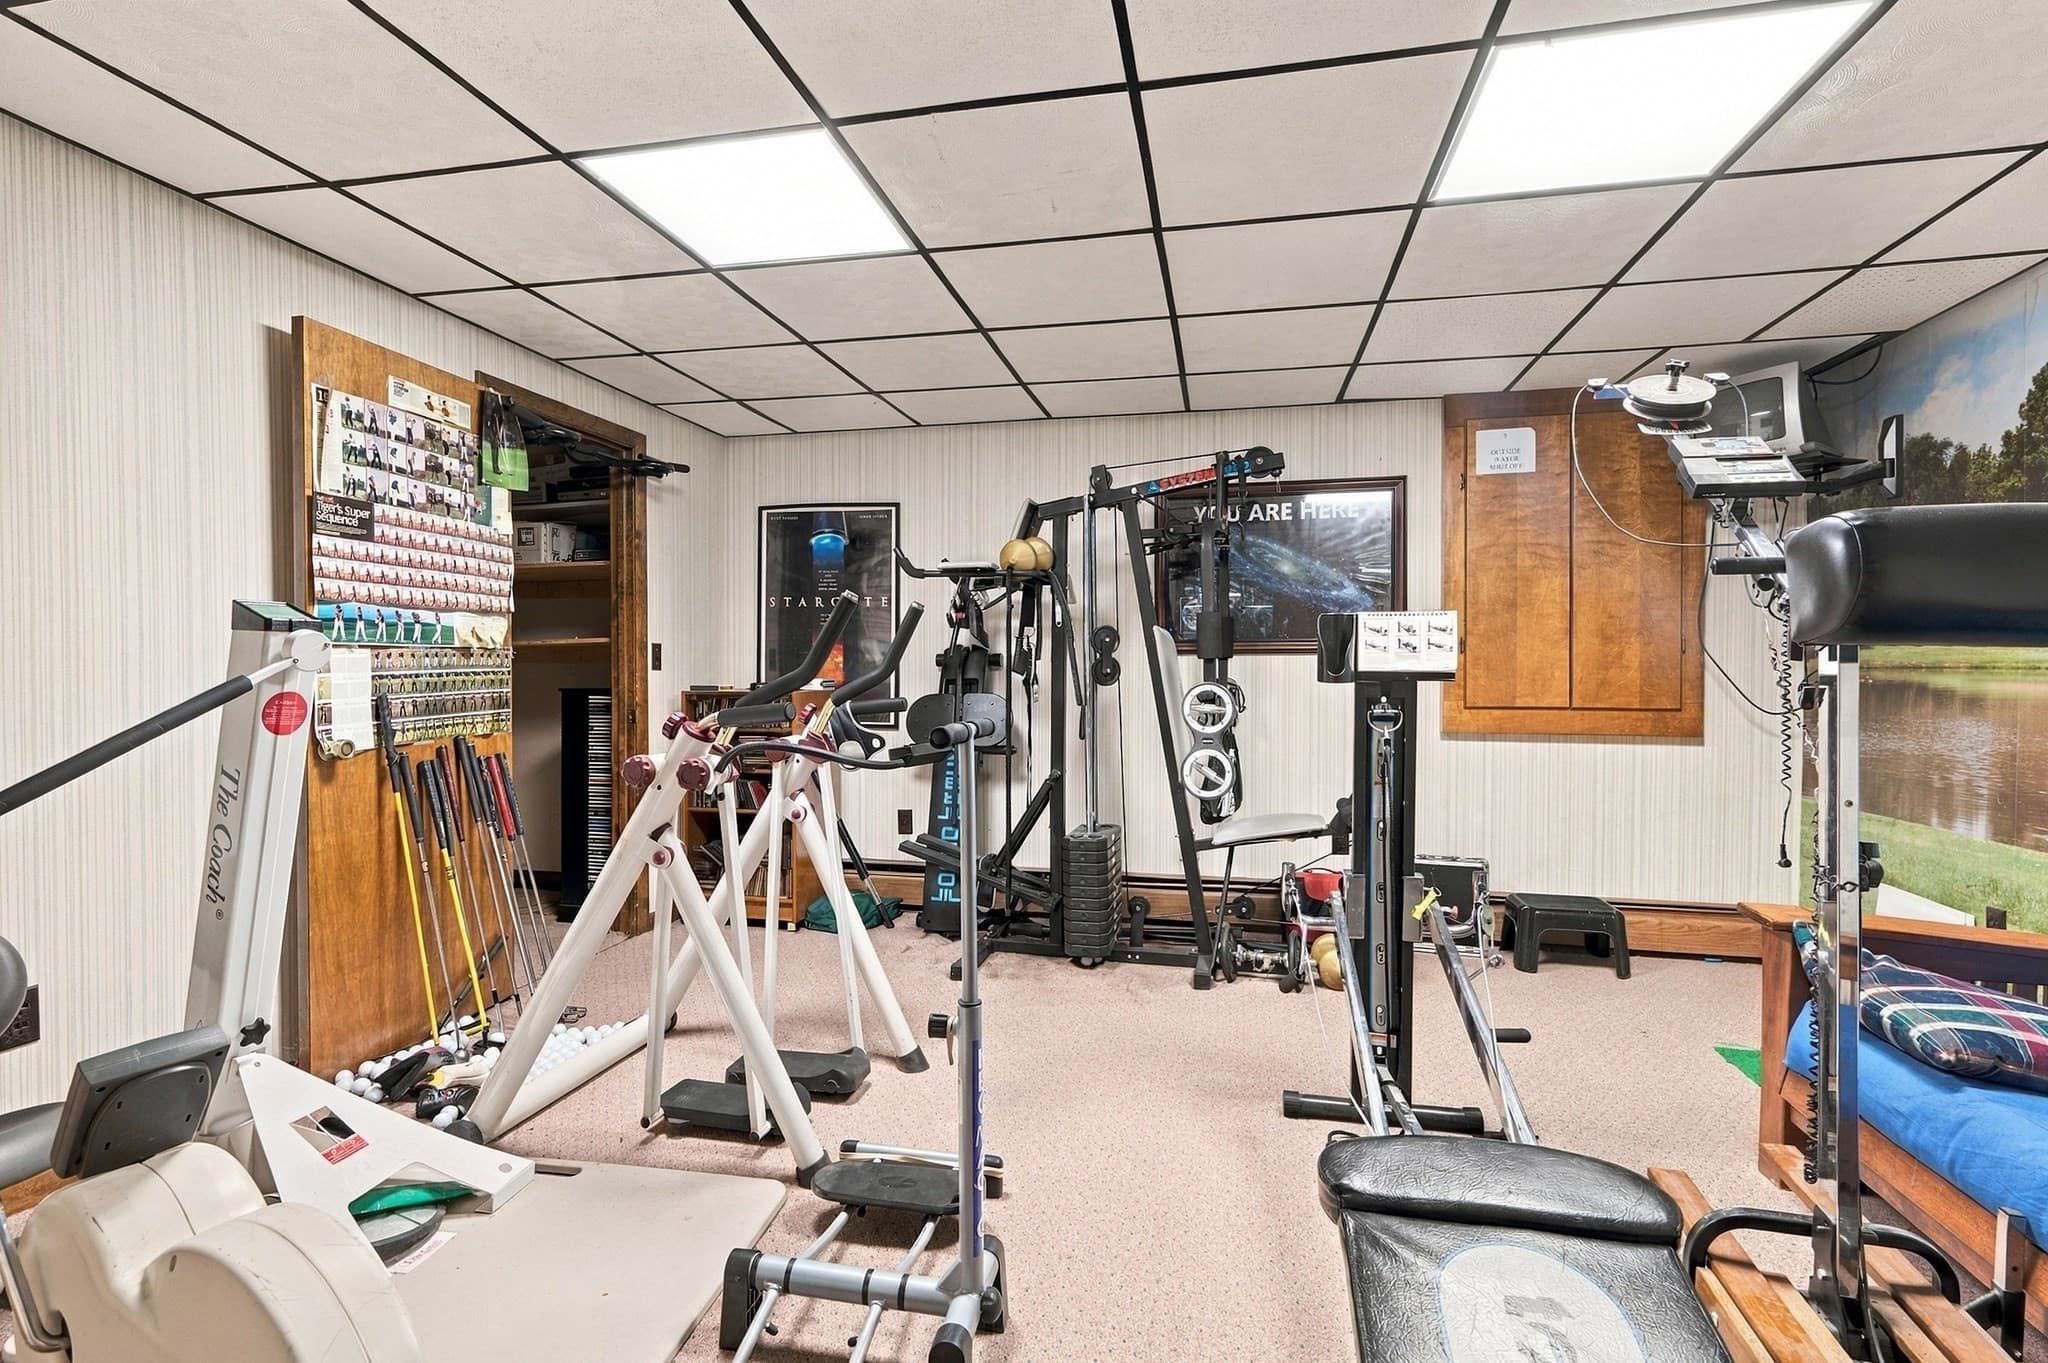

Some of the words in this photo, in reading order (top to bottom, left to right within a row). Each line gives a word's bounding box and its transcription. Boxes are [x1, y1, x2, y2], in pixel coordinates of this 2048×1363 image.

[315, 510, 359, 527] Sequence
[316, 499, 344, 516] Tiger's
[344, 505, 371, 520] Super
[1247, 502, 1293, 522] ARE
[1300, 501, 1361, 520] HERE
[769, 597, 889, 608] STARGTE
[217, 764, 241, 817] The
